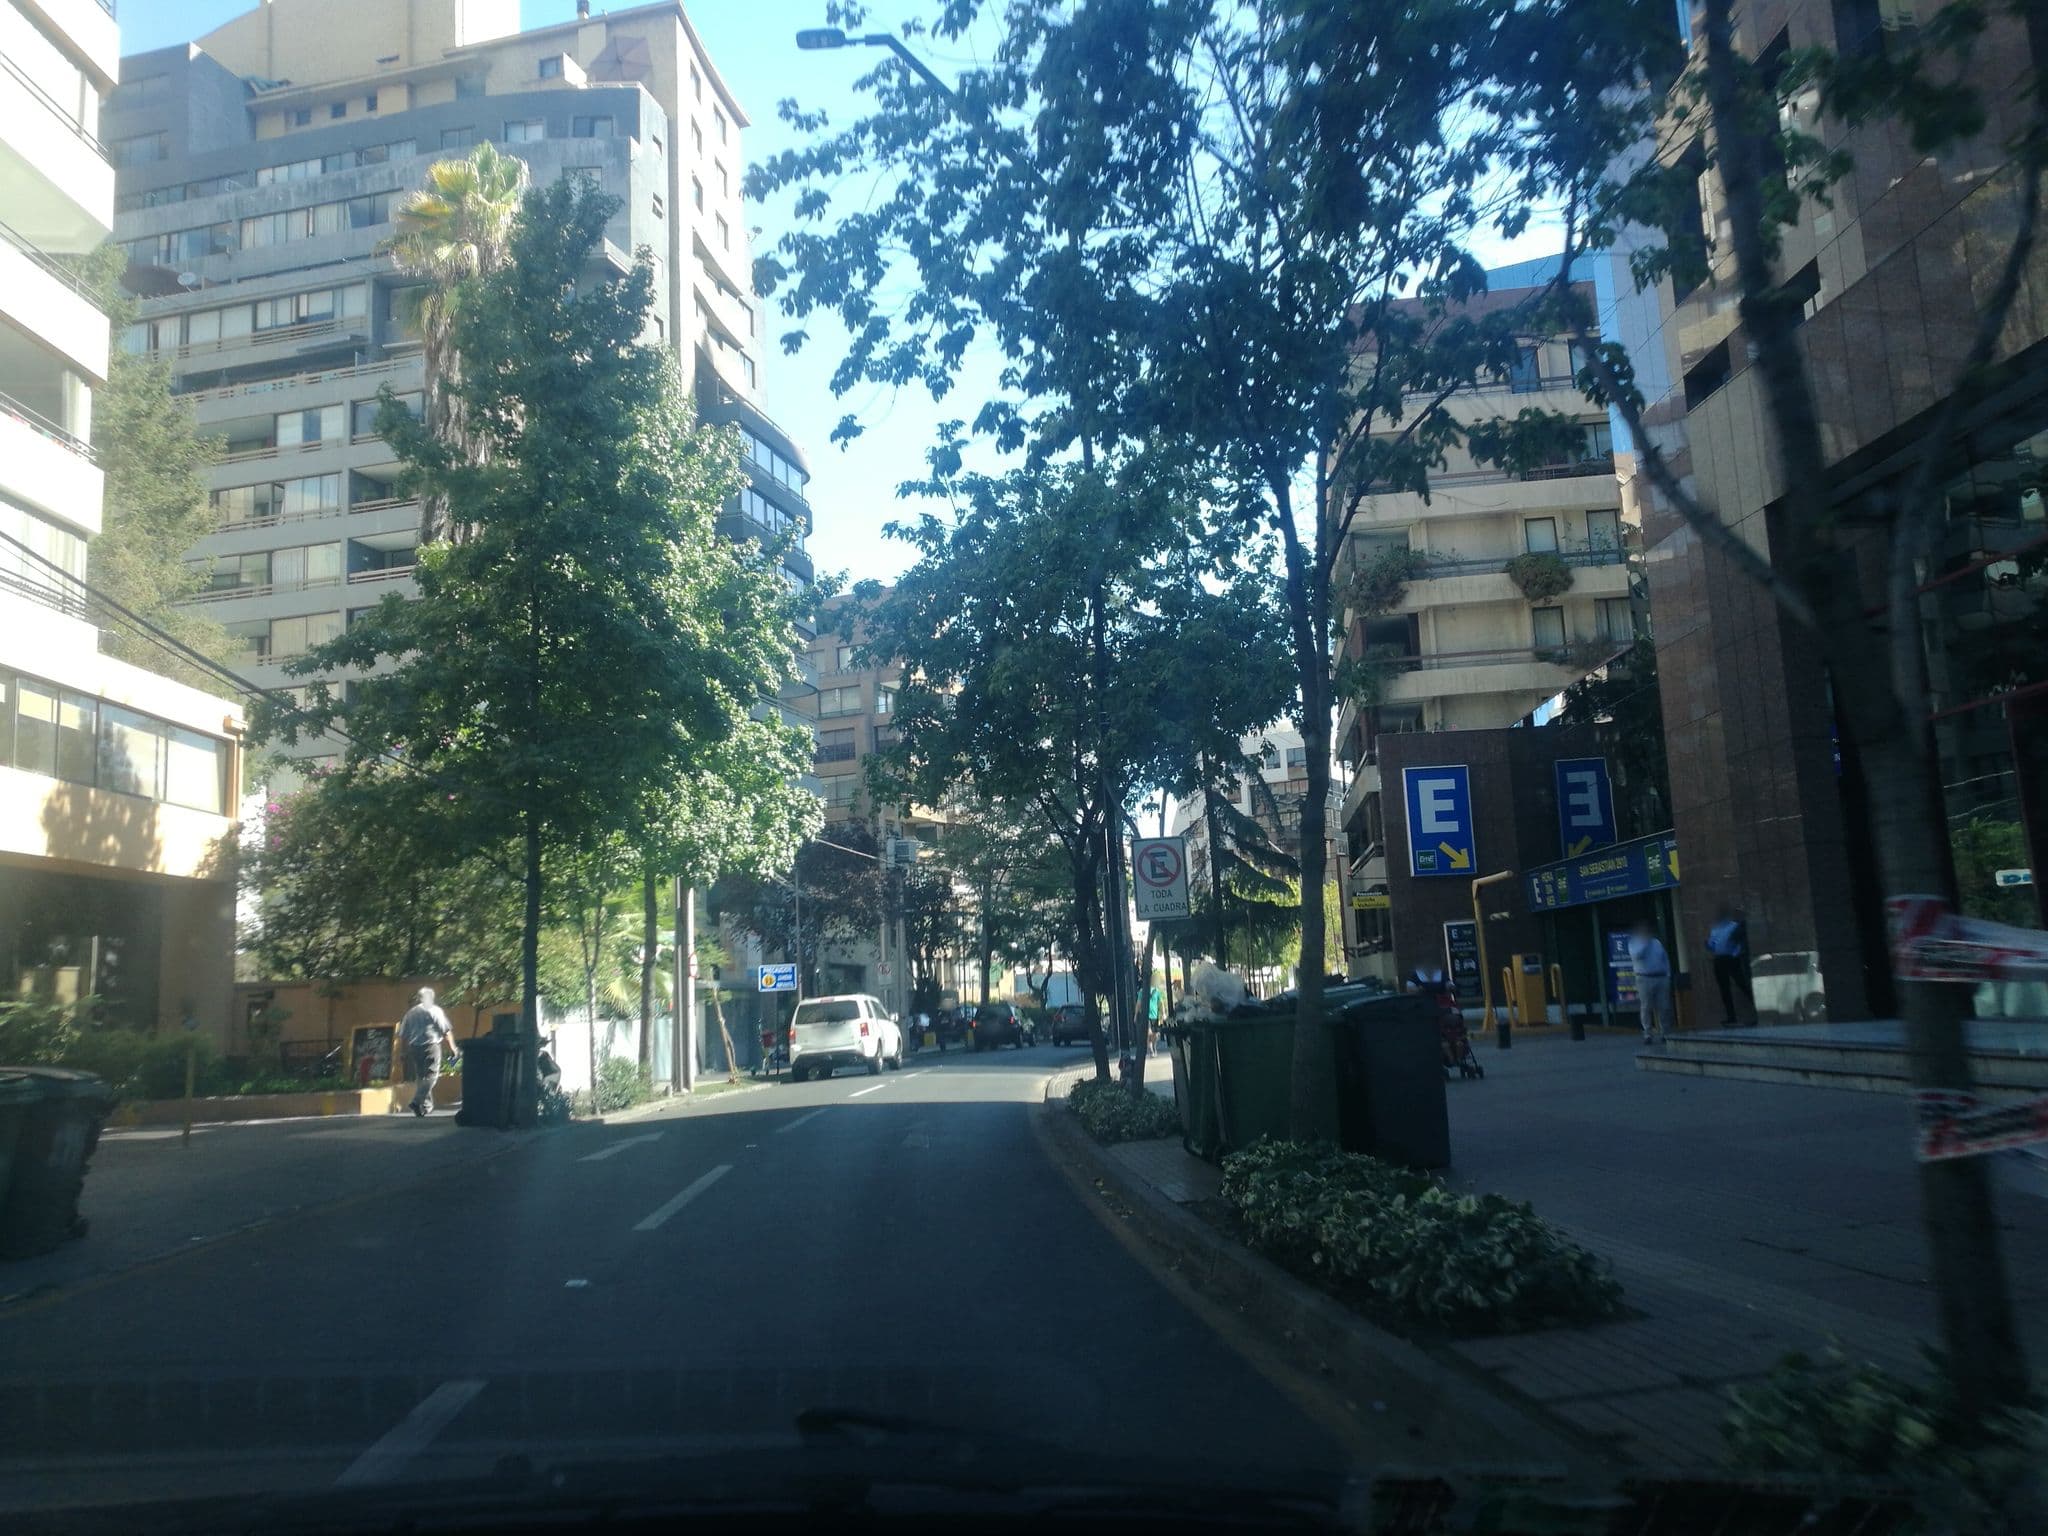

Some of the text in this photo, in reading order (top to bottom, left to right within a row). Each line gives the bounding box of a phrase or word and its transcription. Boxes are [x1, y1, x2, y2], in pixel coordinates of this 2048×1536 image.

[1417, 778, 1459, 834] E
[1151, 889, 1173, 898] TODA
[1139, 903, 1187, 913] LA CUADRA
